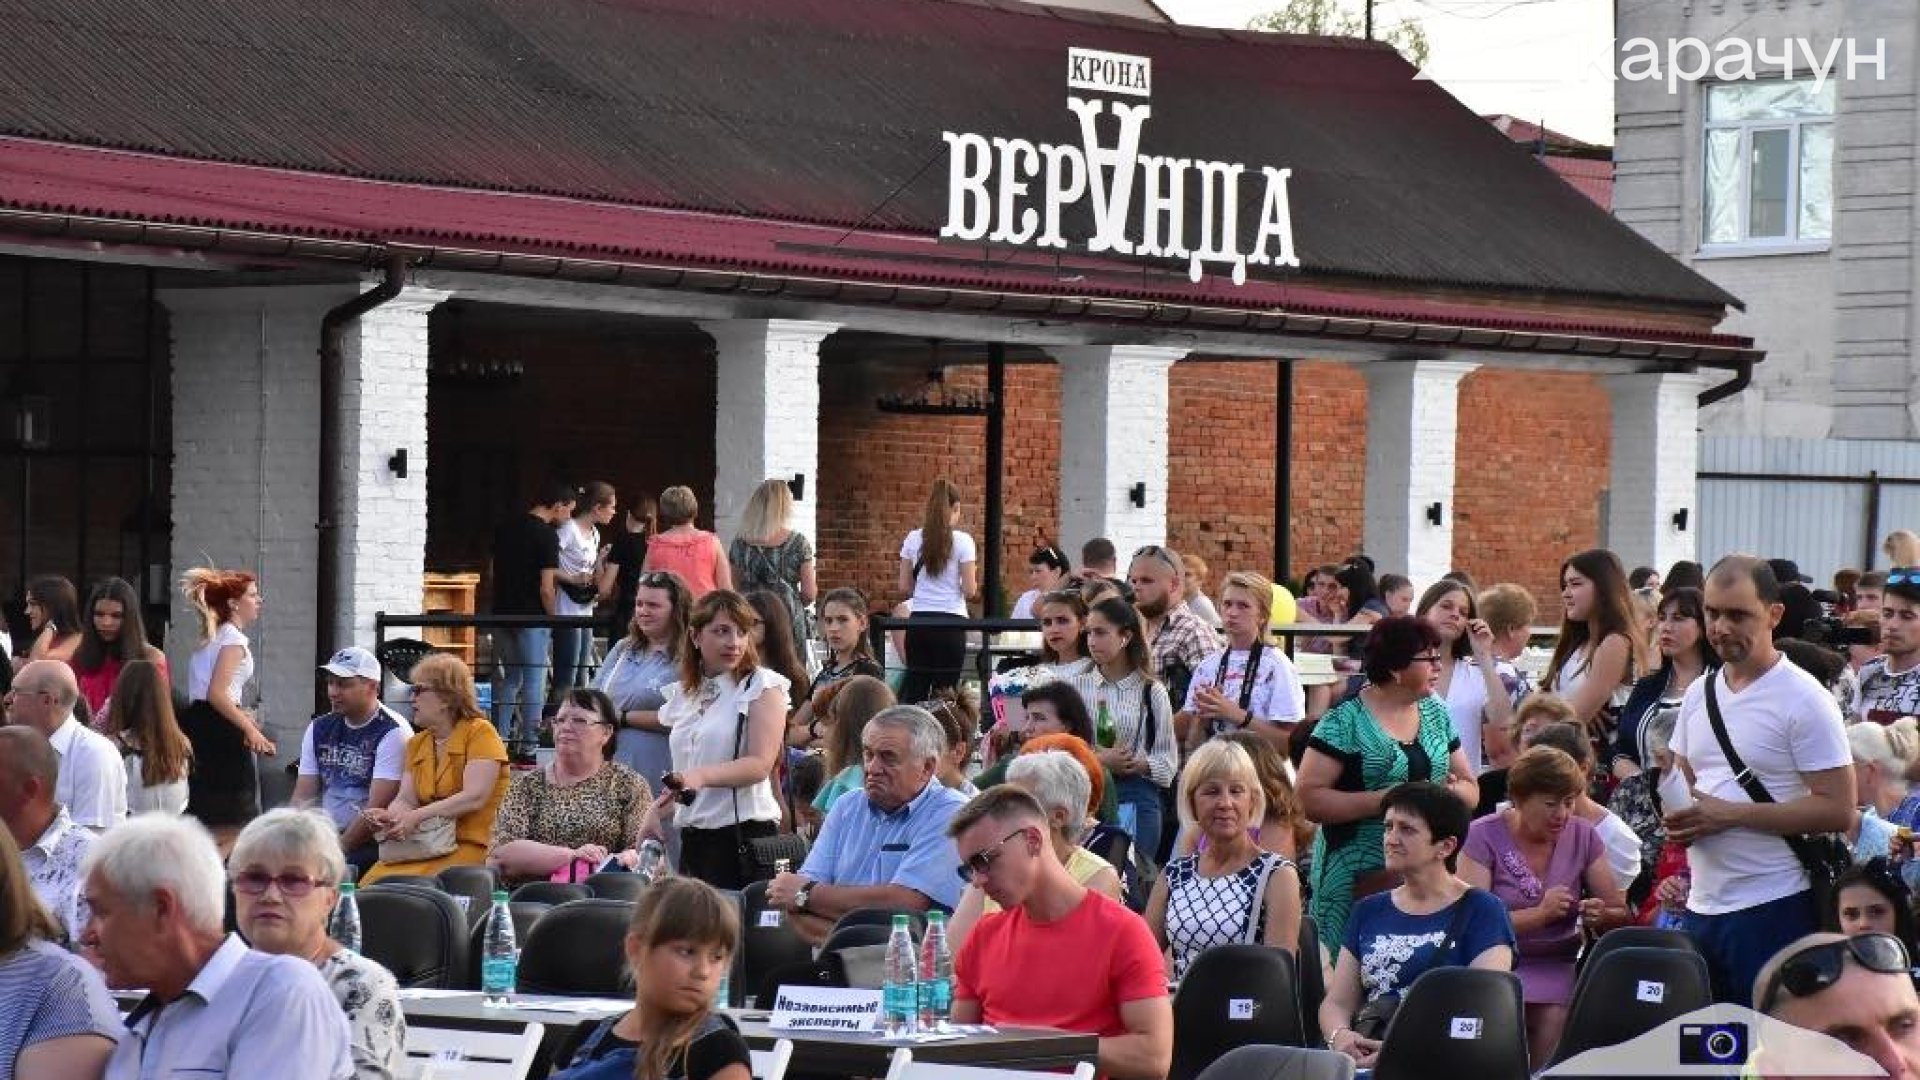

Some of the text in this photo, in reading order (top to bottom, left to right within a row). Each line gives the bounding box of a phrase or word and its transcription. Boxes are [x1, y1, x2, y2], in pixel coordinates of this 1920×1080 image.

[1070, 54, 1148, 89] КРОНА
[940, 97, 1300, 286] ВЕРАНДА
[777, 995, 879, 1014] Независимые
[788, 1017, 861, 1030] эксперты
